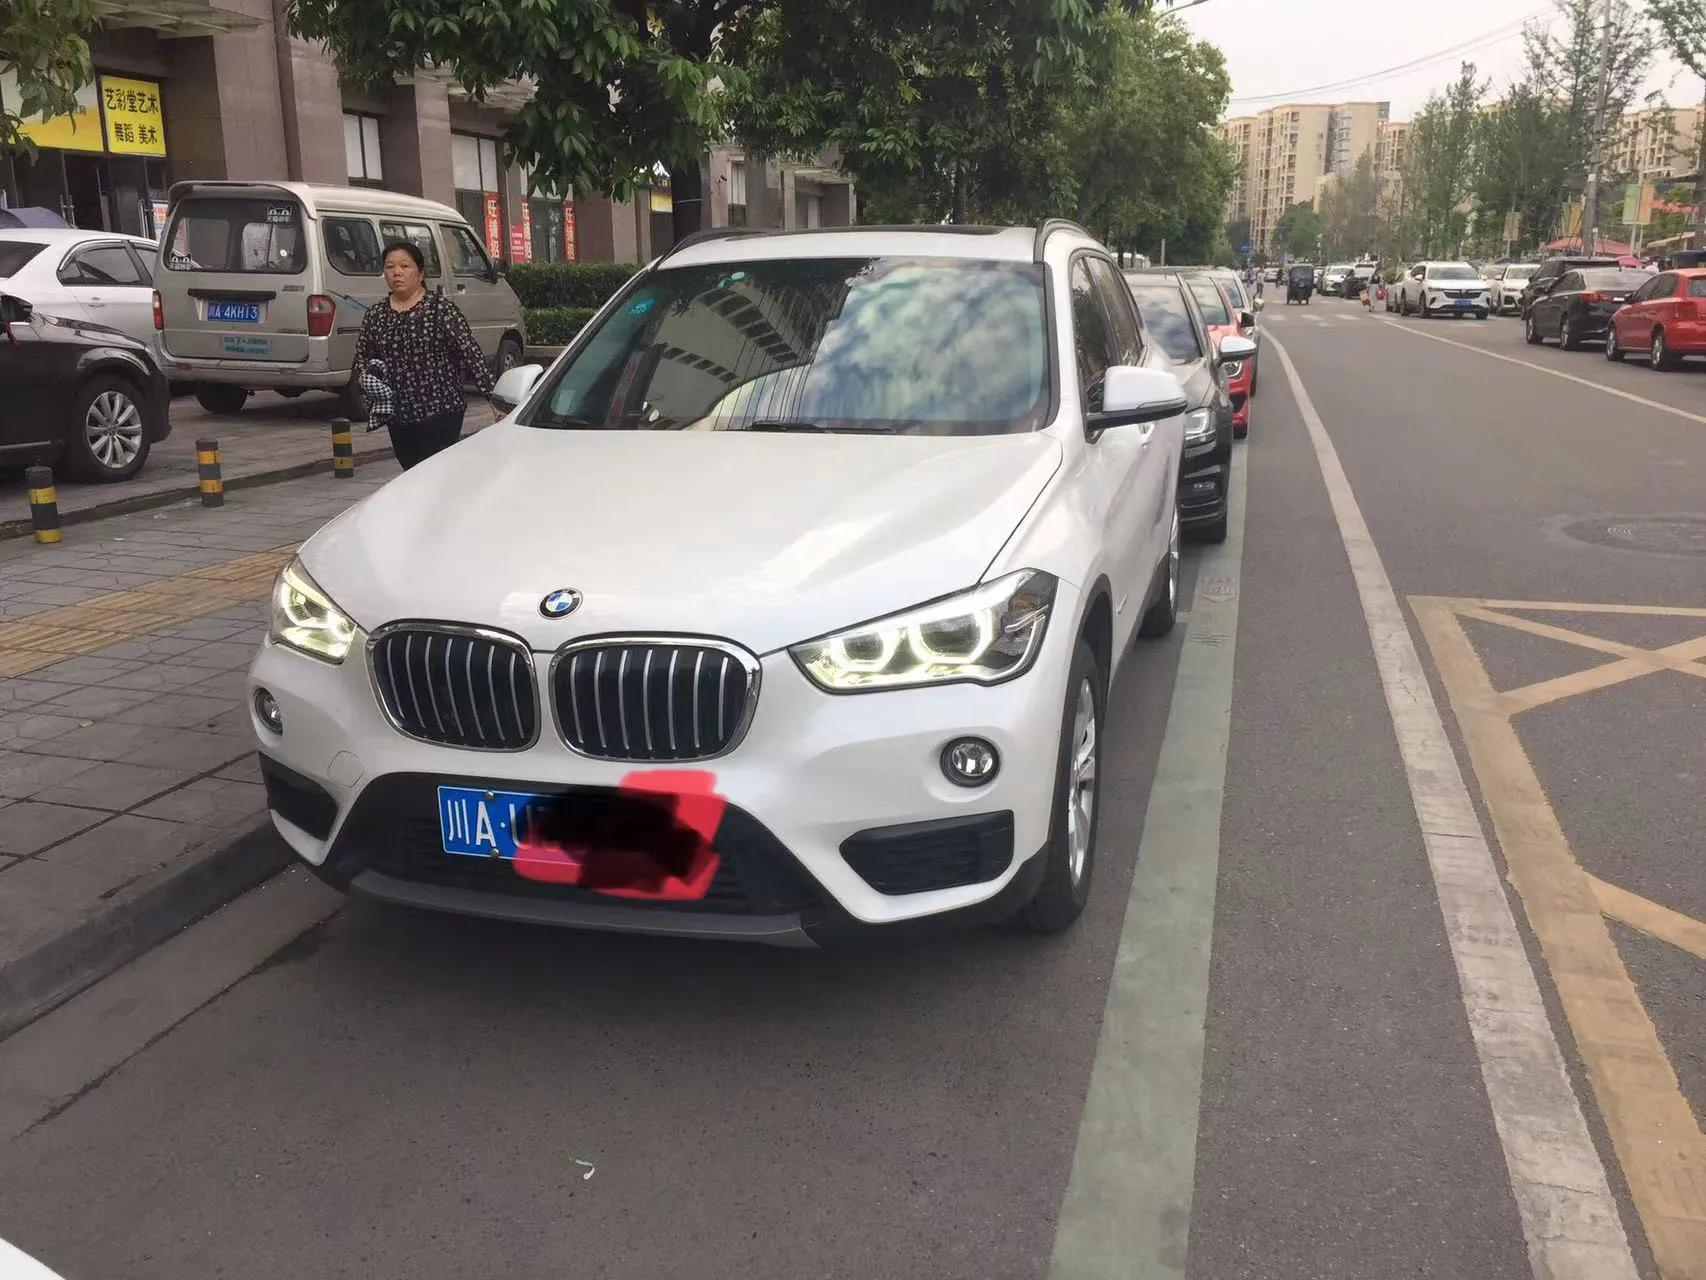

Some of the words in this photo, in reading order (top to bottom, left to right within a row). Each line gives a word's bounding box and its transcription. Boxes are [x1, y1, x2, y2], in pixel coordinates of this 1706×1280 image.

[104, 88, 159, 115] 艺彩堂艺术
[114, 122, 134, 143] 舞蹈
[138, 124, 157, 144] 美术
